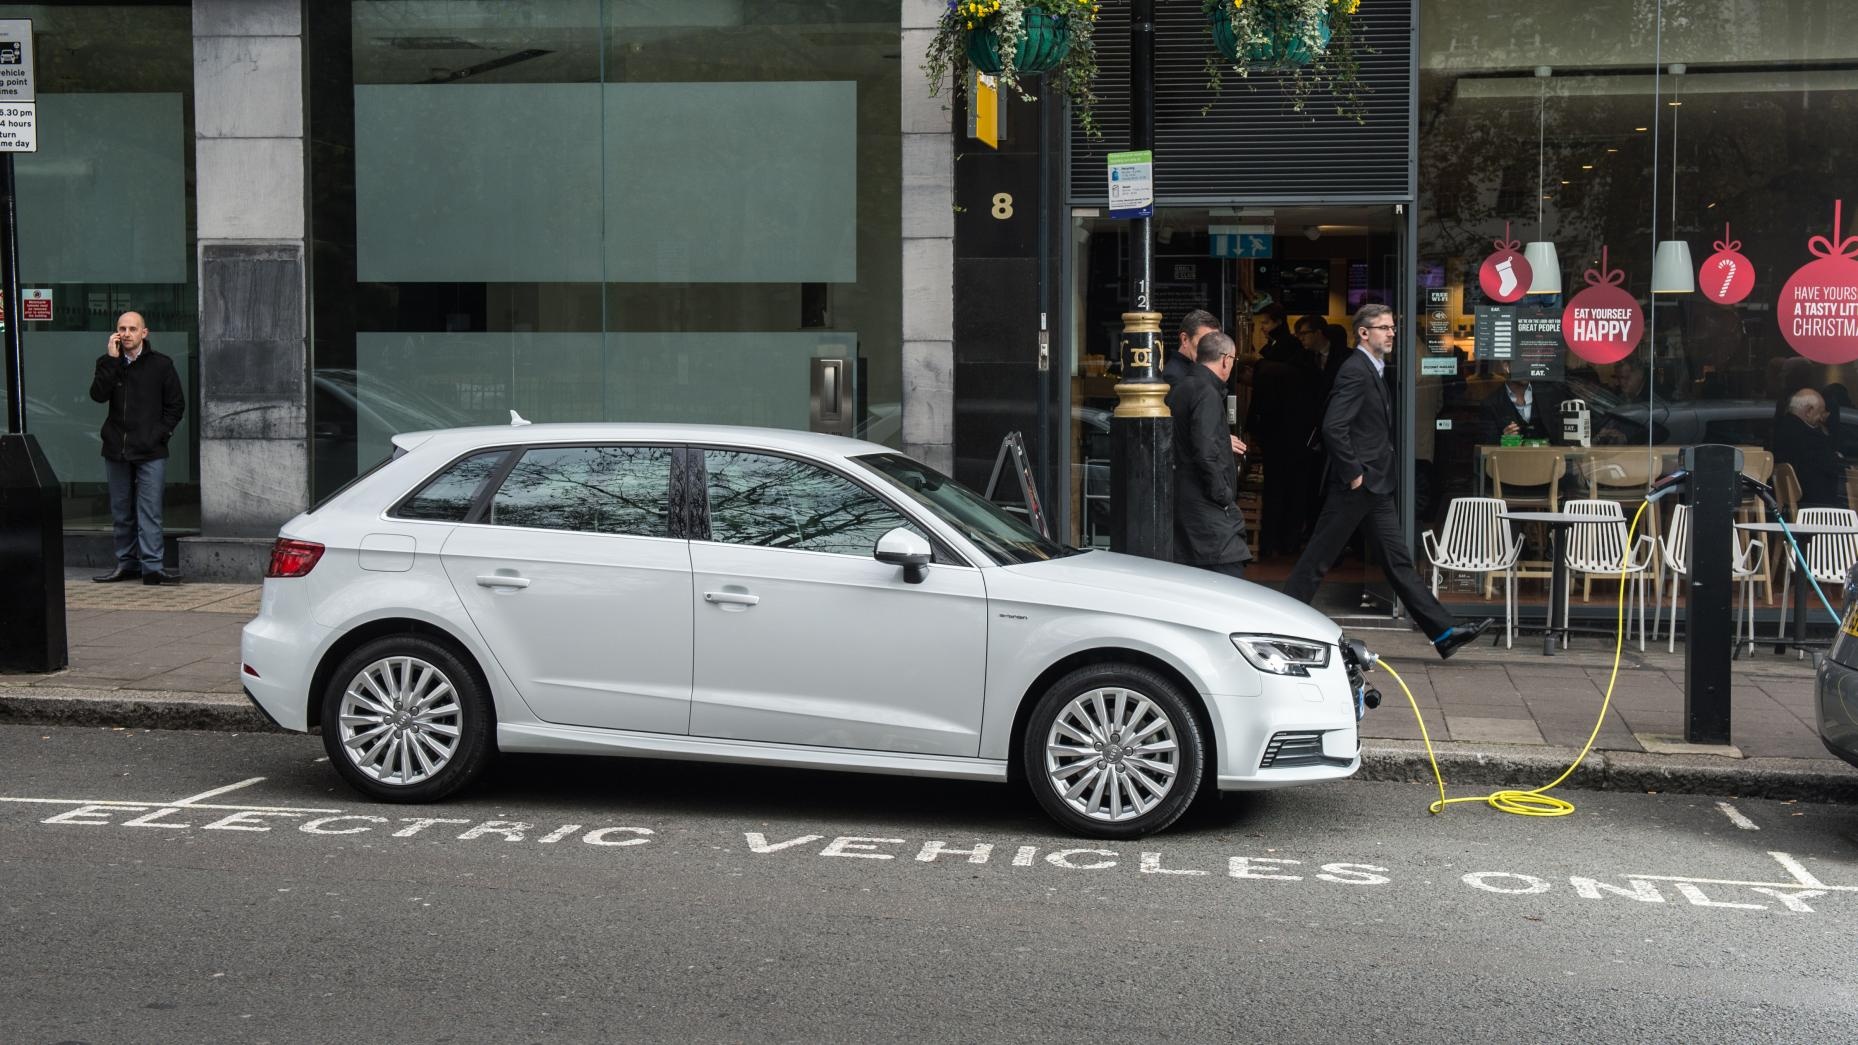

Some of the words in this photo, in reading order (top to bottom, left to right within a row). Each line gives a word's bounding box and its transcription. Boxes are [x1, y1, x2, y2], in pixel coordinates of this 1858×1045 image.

[0, 68, 25, 76] ehicle
[6, 78, 28, 86] point
[15, 139, 30, 148] day
[991, 193, 1014, 220] 8
[1138, 279, 1145, 293] 1
[1794, 286, 1821, 300] HAVE
[1823, 286, 1858, 300] YOURS
[1137, 294, 1146, 308] 2
[1574, 308, 1590, 319] EAT
[1591, 308, 1633, 319] YOURSELF
[1794, 302, 1802, 316] A
[1804, 302, 1838, 316] TASTY
[1517, 323, 1538, 332] GREAT
[1538, 323, 1561, 332] PEOPLE
[1573, 320, 1632, 342] HAPPY
[40, 804, 655, 847] ELECTRIC
[743, 832, 1391, 886] VEHICLES
[1460, 871, 1828, 913] ONLY
